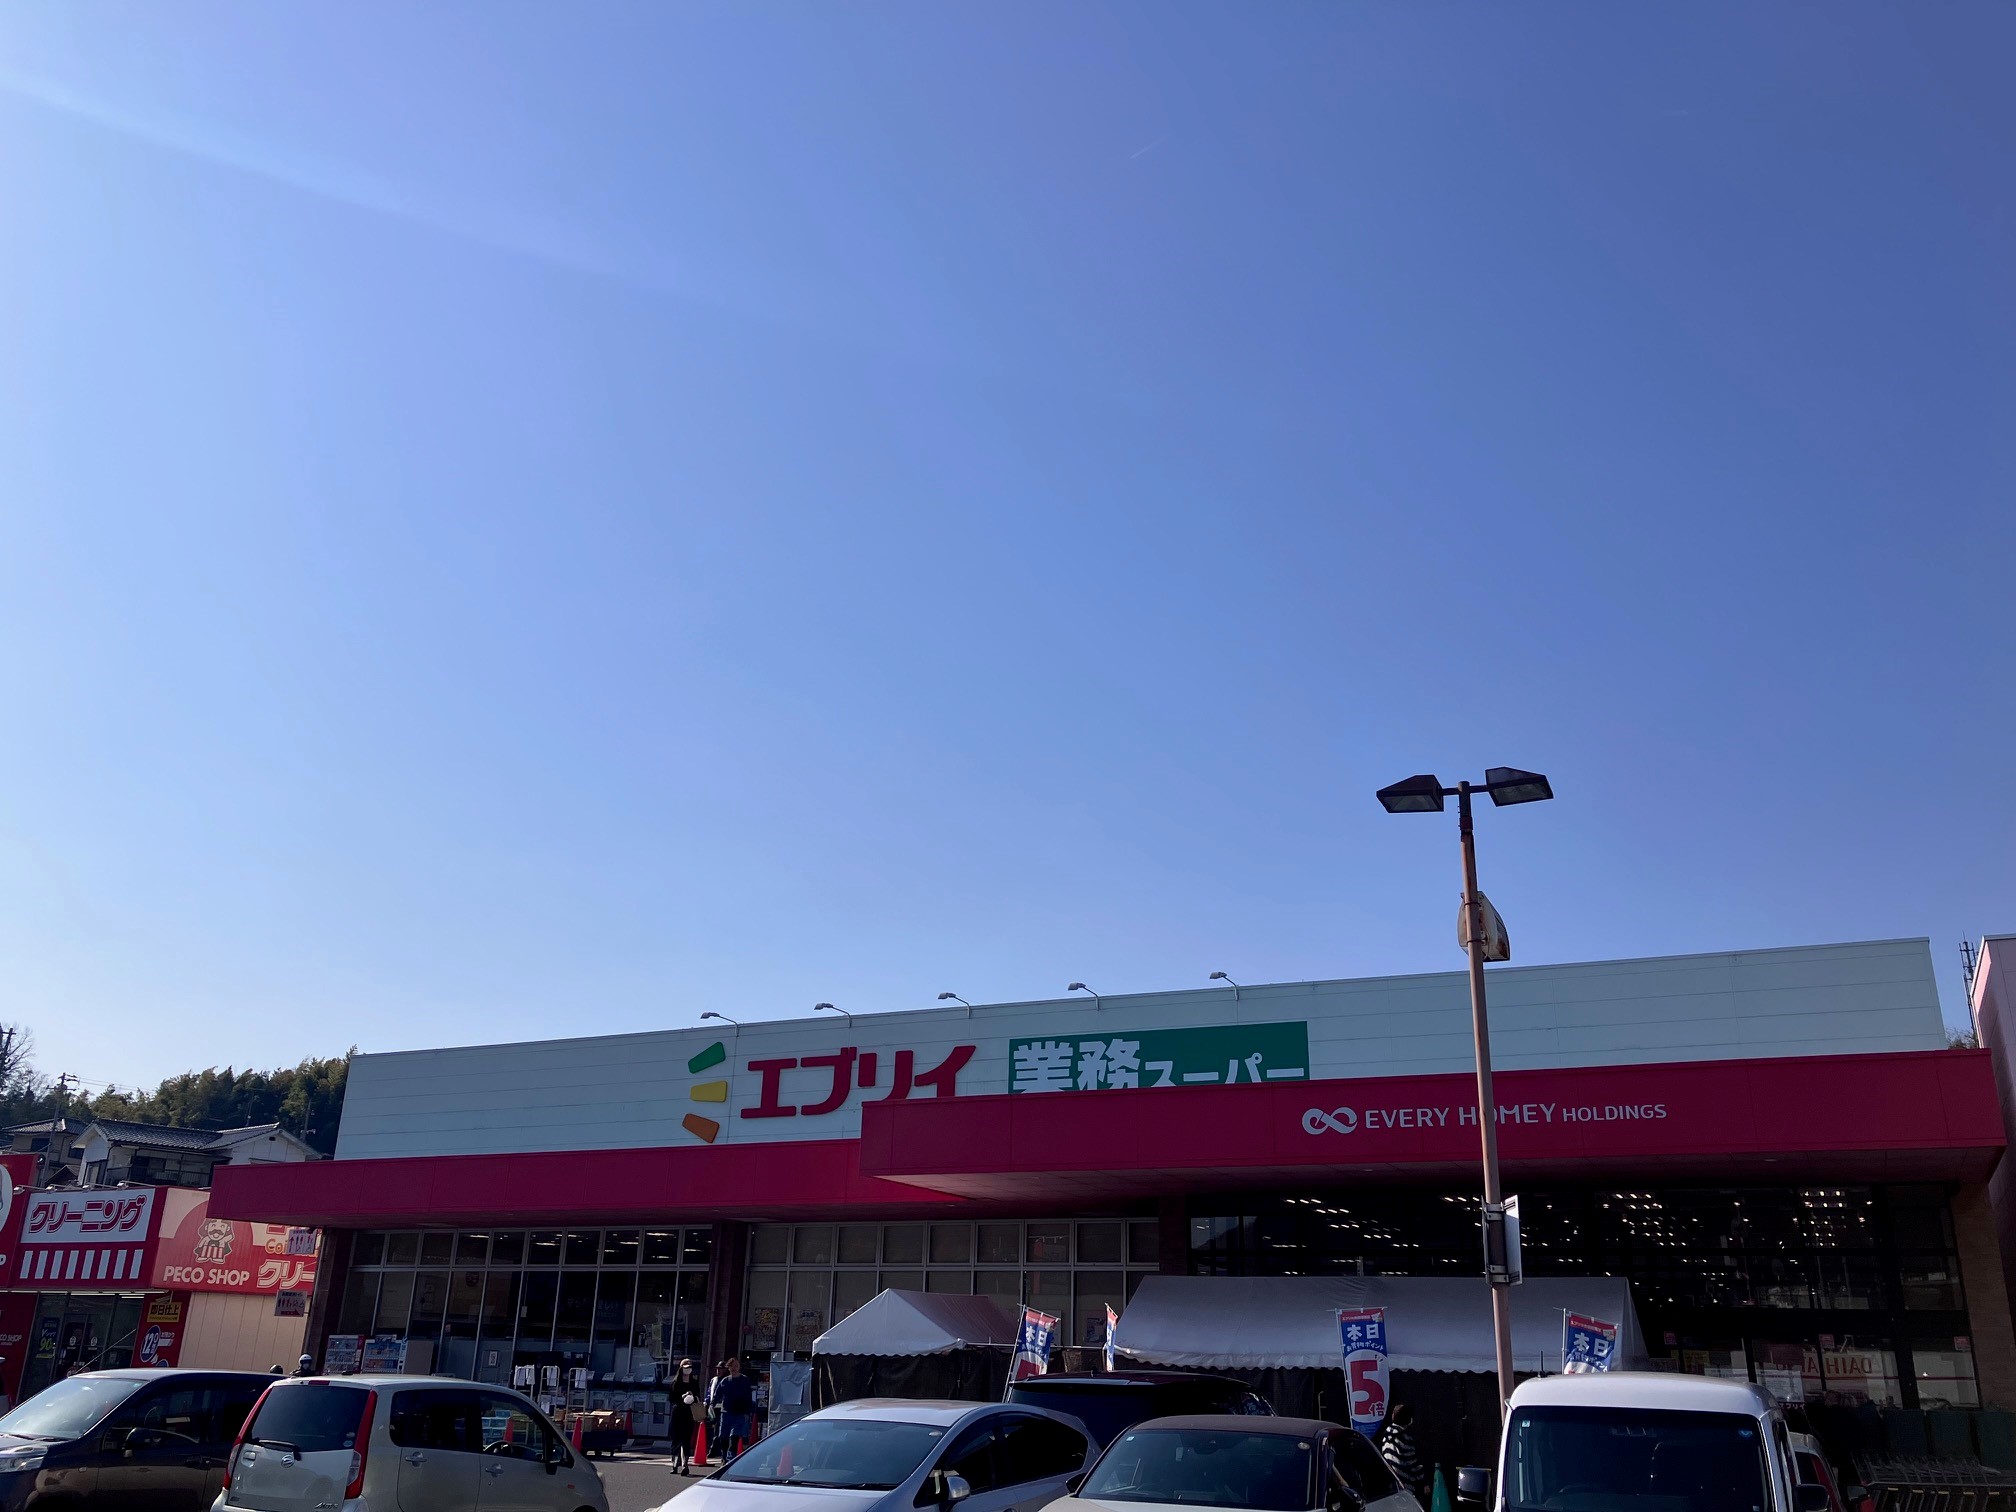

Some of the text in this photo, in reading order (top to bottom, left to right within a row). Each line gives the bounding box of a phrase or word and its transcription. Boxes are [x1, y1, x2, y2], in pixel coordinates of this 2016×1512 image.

[1012, 1038, 1305, 1093] 業務スーパー
[740, 1045, 977, 1119] エブリイ
[1365, 1103, 1668, 1129] EVERY HMEY HOLDINGS
[29, 1195, 148, 1233] クリーニング
[162, 1265, 250, 1287] PECO SHOP
[1026, 1325, 1048, 1347] 本日
[1346, 1323, 1380, 1341] 本日
[1573, 1332, 1610, 1359] 本日
